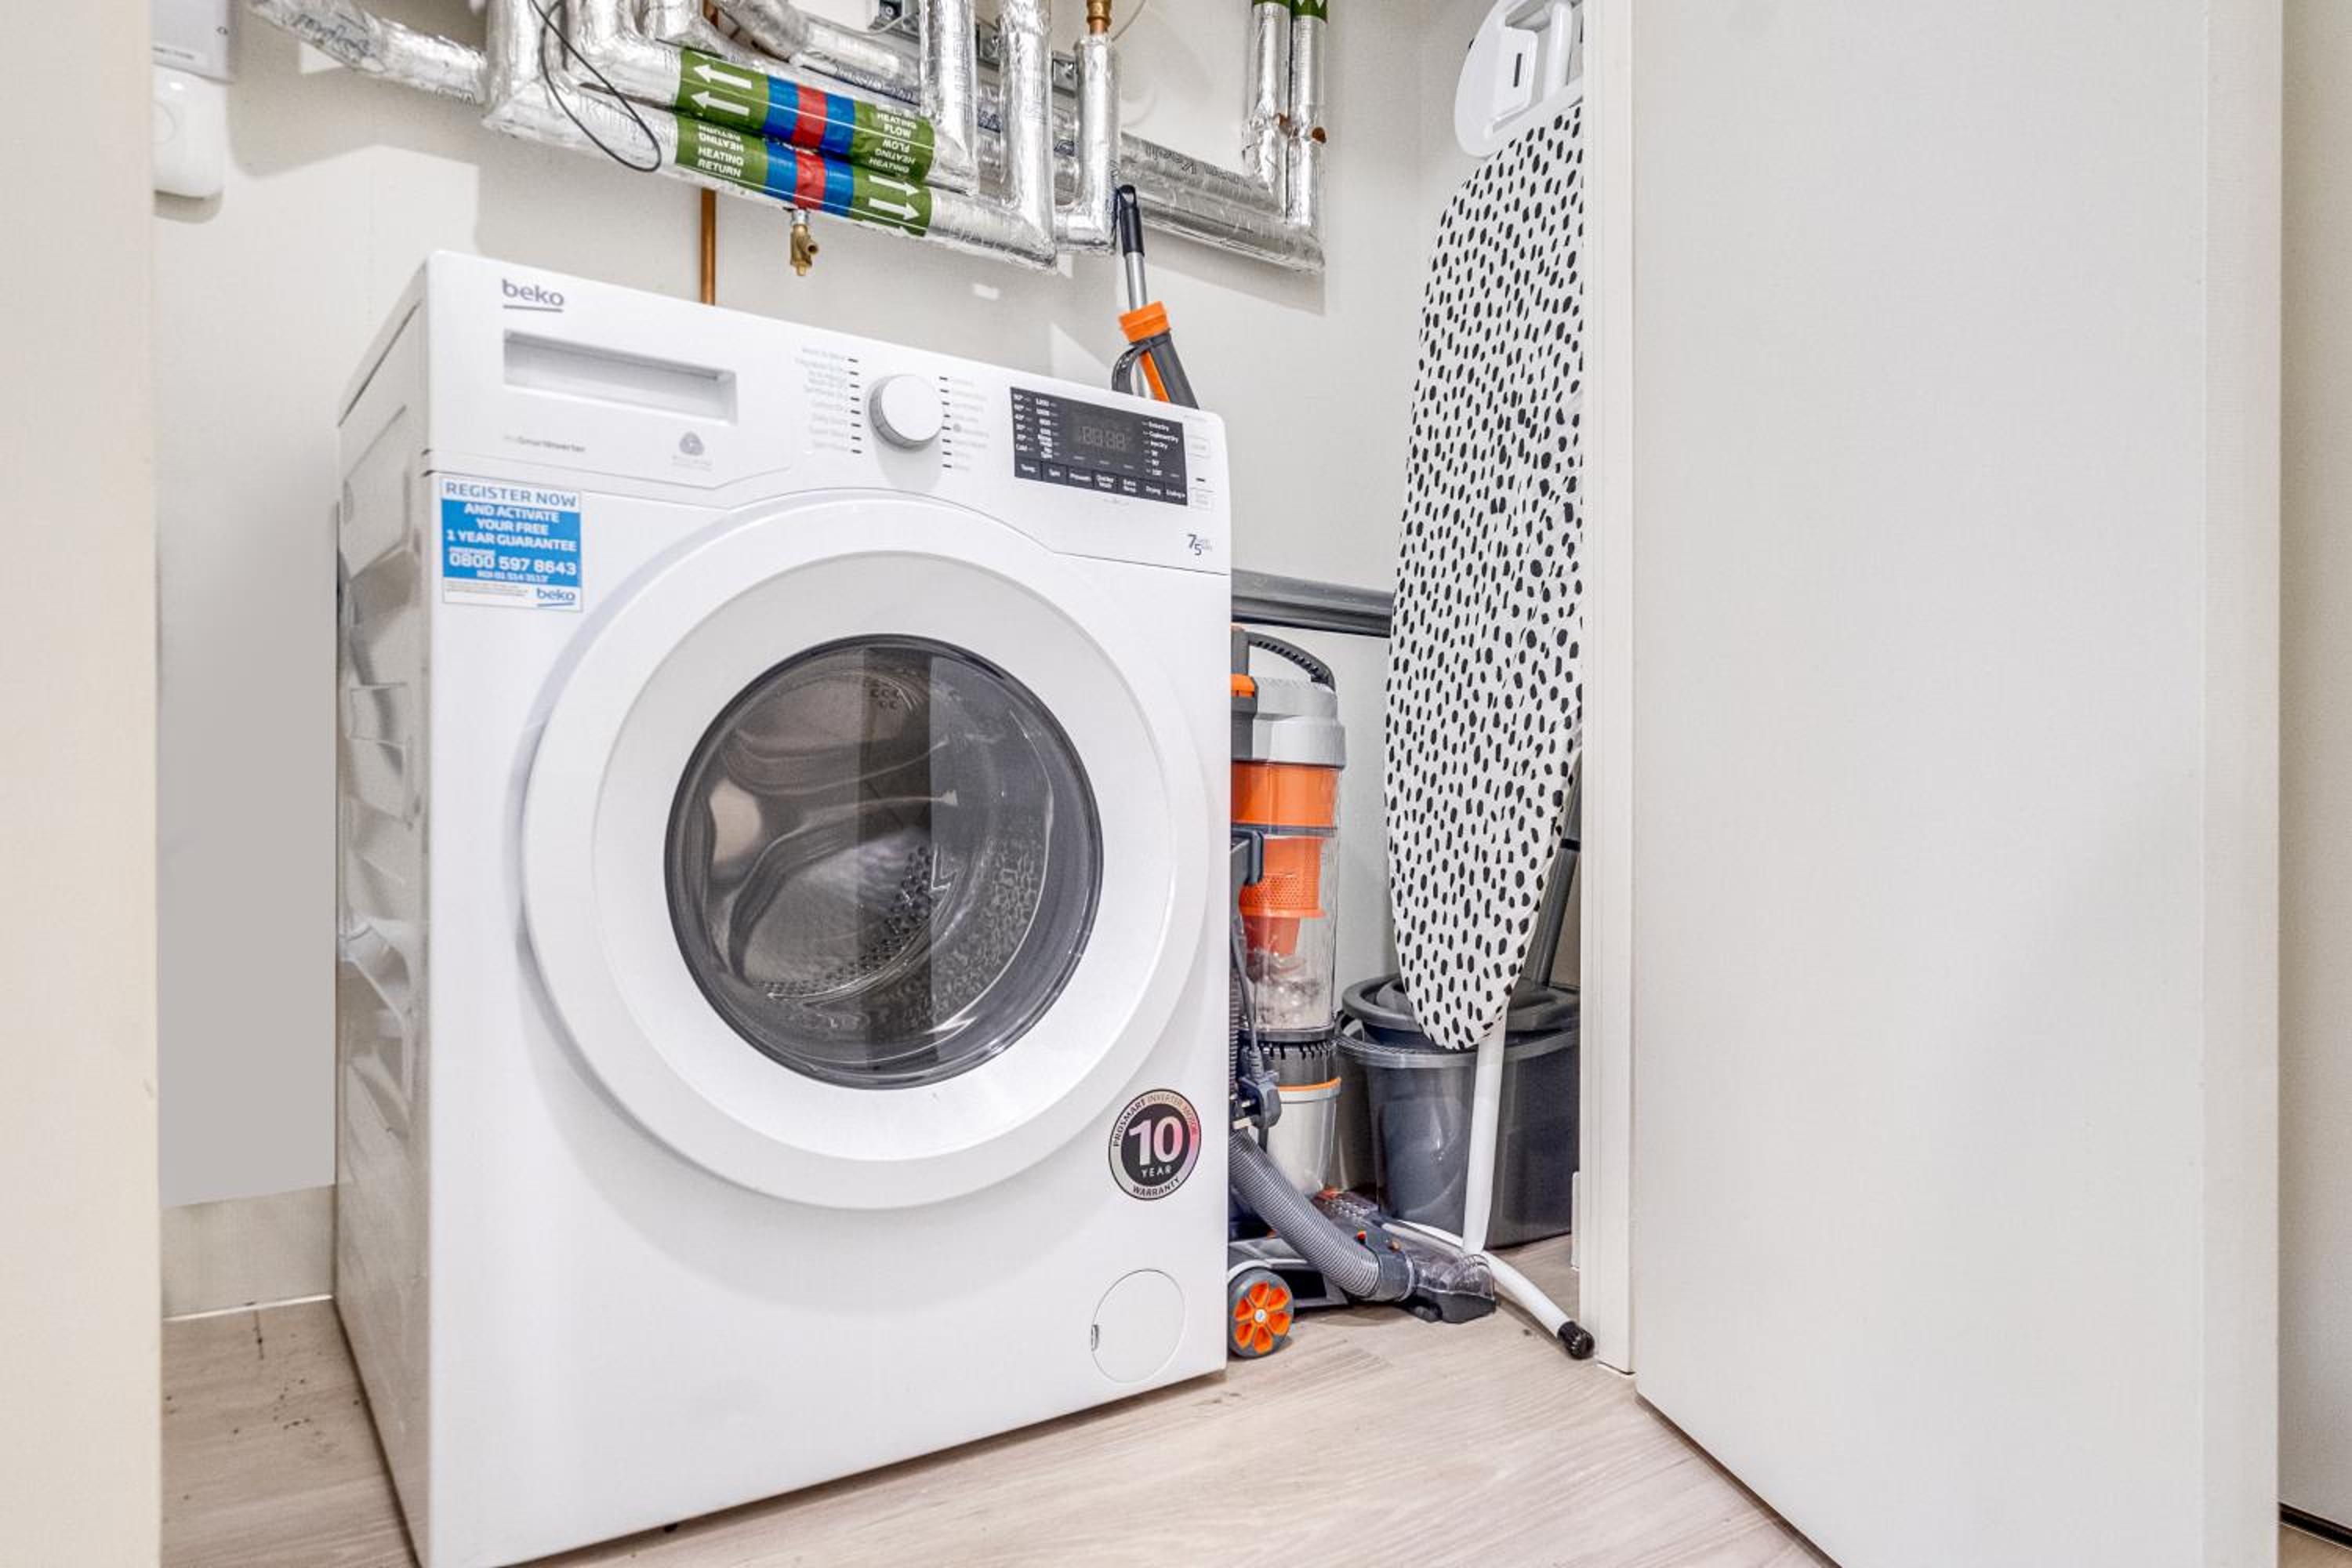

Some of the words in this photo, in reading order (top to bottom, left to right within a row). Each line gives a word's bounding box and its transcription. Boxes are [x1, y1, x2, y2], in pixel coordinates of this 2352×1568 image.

[877, 113, 916, 129] HEATING
[884, 123, 911, 138] FLOW
[698, 145, 744, 166] HEATING
[882, 139, 910, 153] FLOW
[875, 148, 916, 164] HEATING
[698, 158, 741, 178] RETURN
[502, 278, 564, 307] beko
[445, 481, 532, 502] REGISTER
[536, 492, 576, 507] NOW
[464, 503, 495, 516] AND
[496, 506, 561, 523] ACTIVATE
[476, 517, 514, 532] YOUR
[516, 521, 549, 535] FREE
[446, 529, 456, 541] 1
[457, 530, 495, 544] YEAR
[497, 533, 577, 552] GUARANTEE
[1187, 533, 1197, 549] 7
[1194, 543, 1202, 556] 5
[449, 552, 495, 569] 0800
[499, 556, 530, 572] 597
[536, 587, 575, 601] beko
[1112, 1098, 1145, 1148] PROSMART
[1128, 1116, 1184, 1166] 10
[1142, 1165, 1172, 1178] YEAR
[1132, 1178, 1180, 1197] WARRANTY
